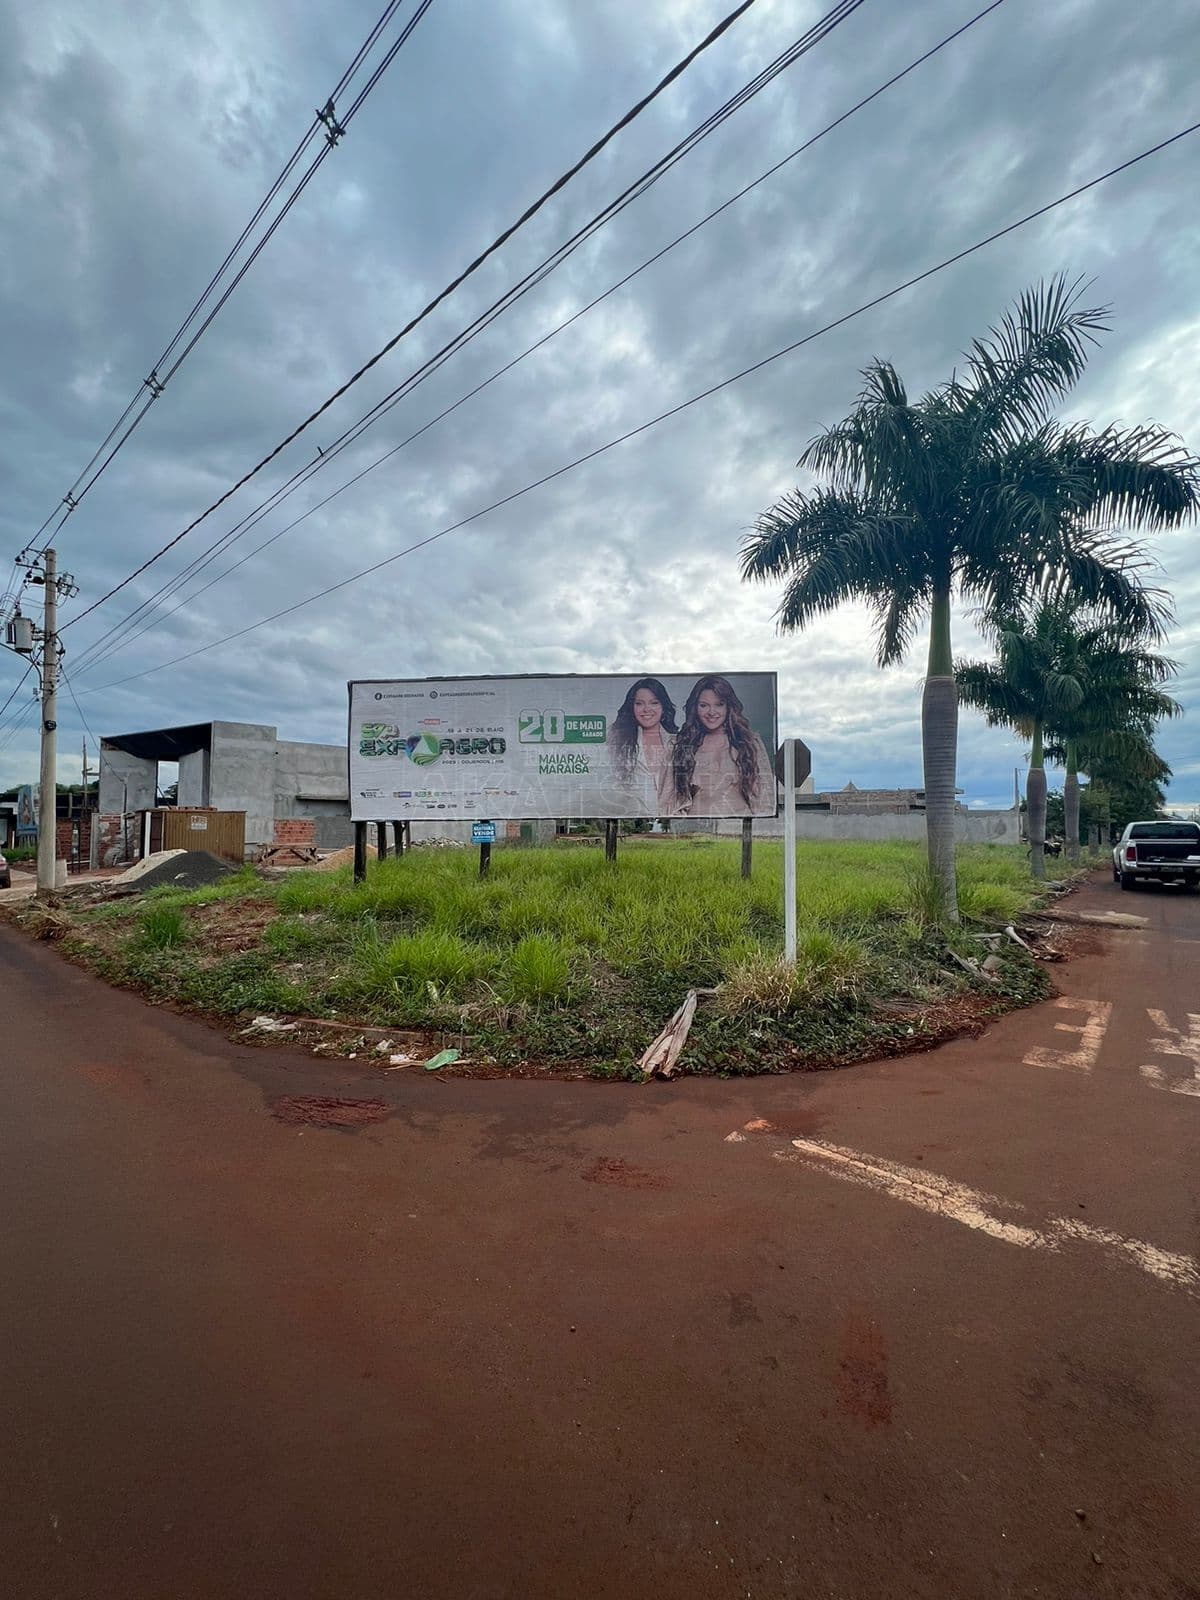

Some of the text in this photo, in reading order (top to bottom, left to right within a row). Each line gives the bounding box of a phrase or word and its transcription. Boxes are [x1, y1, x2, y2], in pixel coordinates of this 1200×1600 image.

[520, 709, 565, 743] 20
[566, 721, 604, 730] DE MAIO
[539, 753, 582, 764] MAIARA
[539, 764, 590, 775] MARAISA
